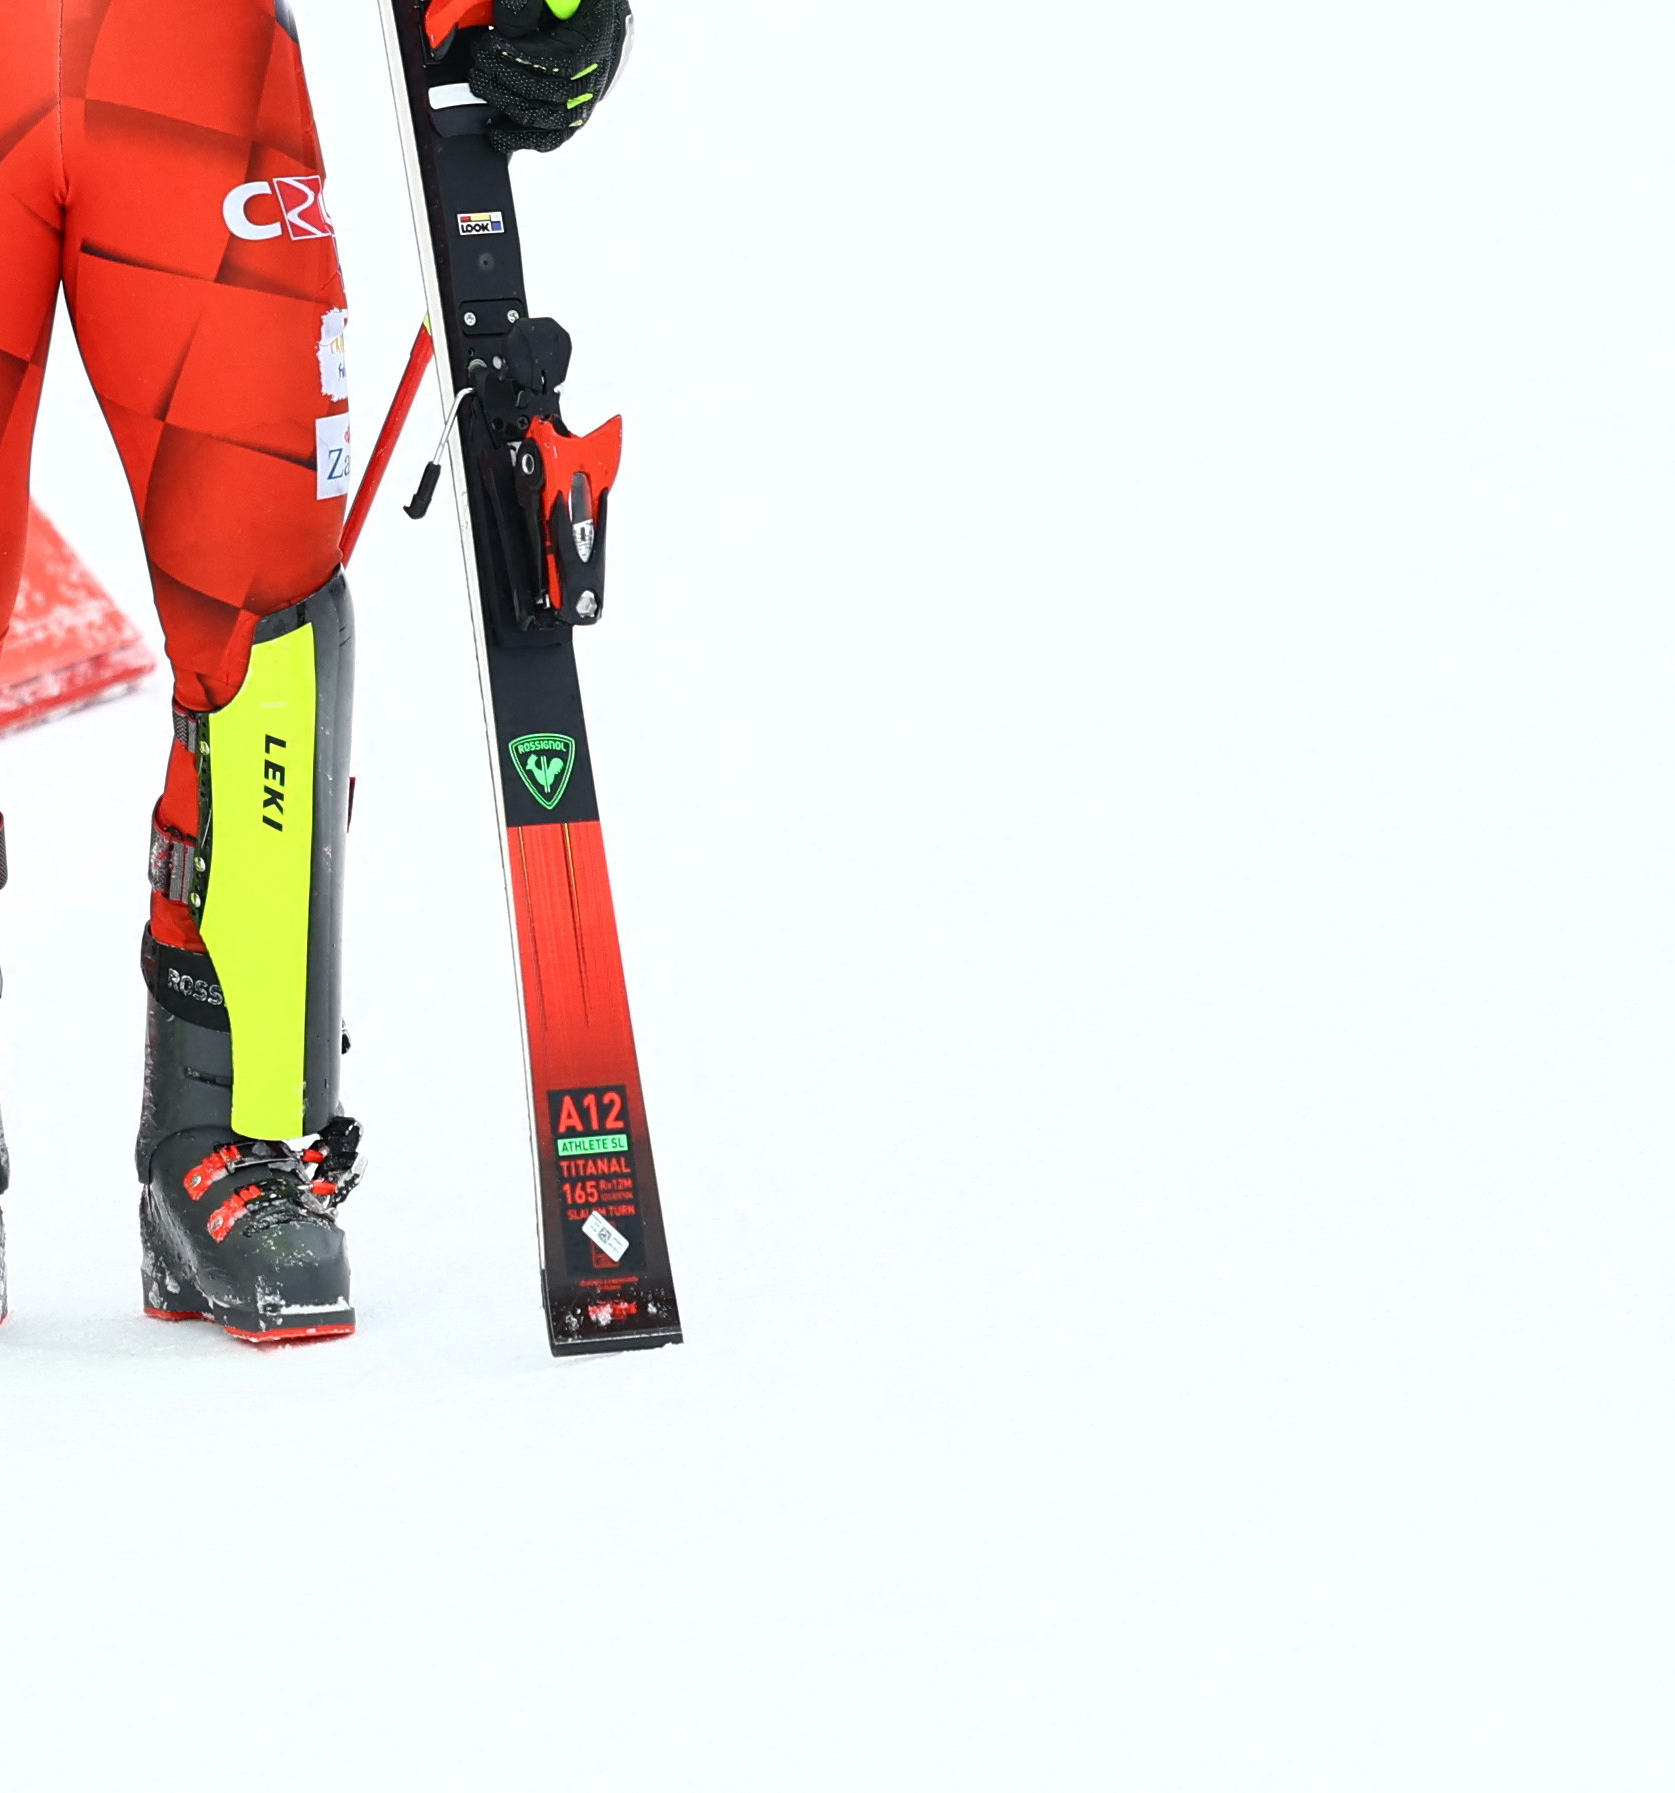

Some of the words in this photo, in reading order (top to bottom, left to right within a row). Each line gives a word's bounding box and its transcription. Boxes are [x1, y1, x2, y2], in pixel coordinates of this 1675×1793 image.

[459, 221, 491, 235] LOOK
[517, 739, 567, 755] ROSSIGNOL
[261, 734, 287, 833] LEKI
[557, 1091, 626, 1134] A12
[561, 1137, 609, 1153] ATHLETE
[611, 1136, 625, 1150] SL
[559, 1156, 632, 1180] TITANAL
[562, 1181, 600, 1206] 165
[608, 1204, 637, 1217] TURN
